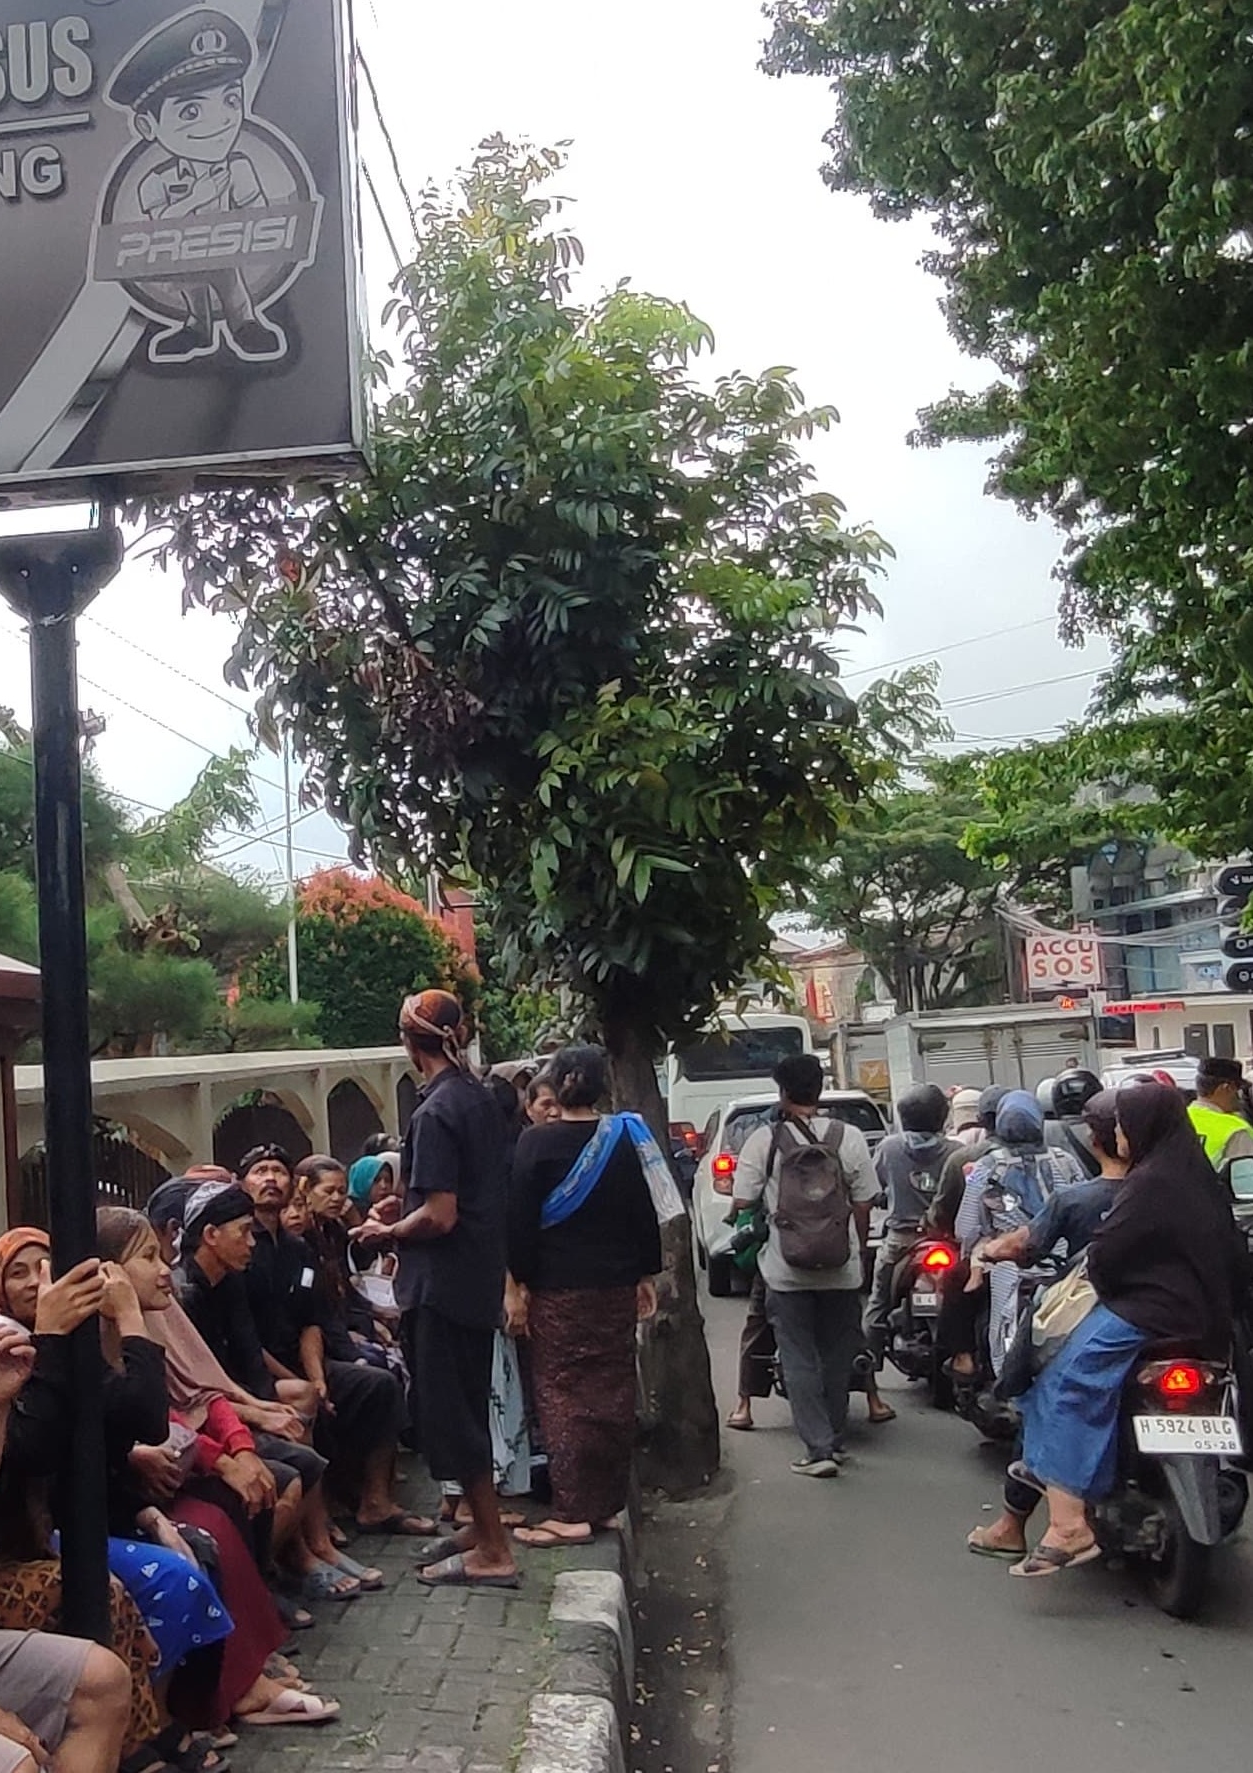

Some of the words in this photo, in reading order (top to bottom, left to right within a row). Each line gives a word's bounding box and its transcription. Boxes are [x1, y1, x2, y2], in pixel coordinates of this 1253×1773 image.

[117, 217, 295, 267] PRESISI
[1032, 939, 1092, 956] ACCU
[1140, 1419, 1150, 1433] H
[1202, 1420, 1231, 1434] BLG
